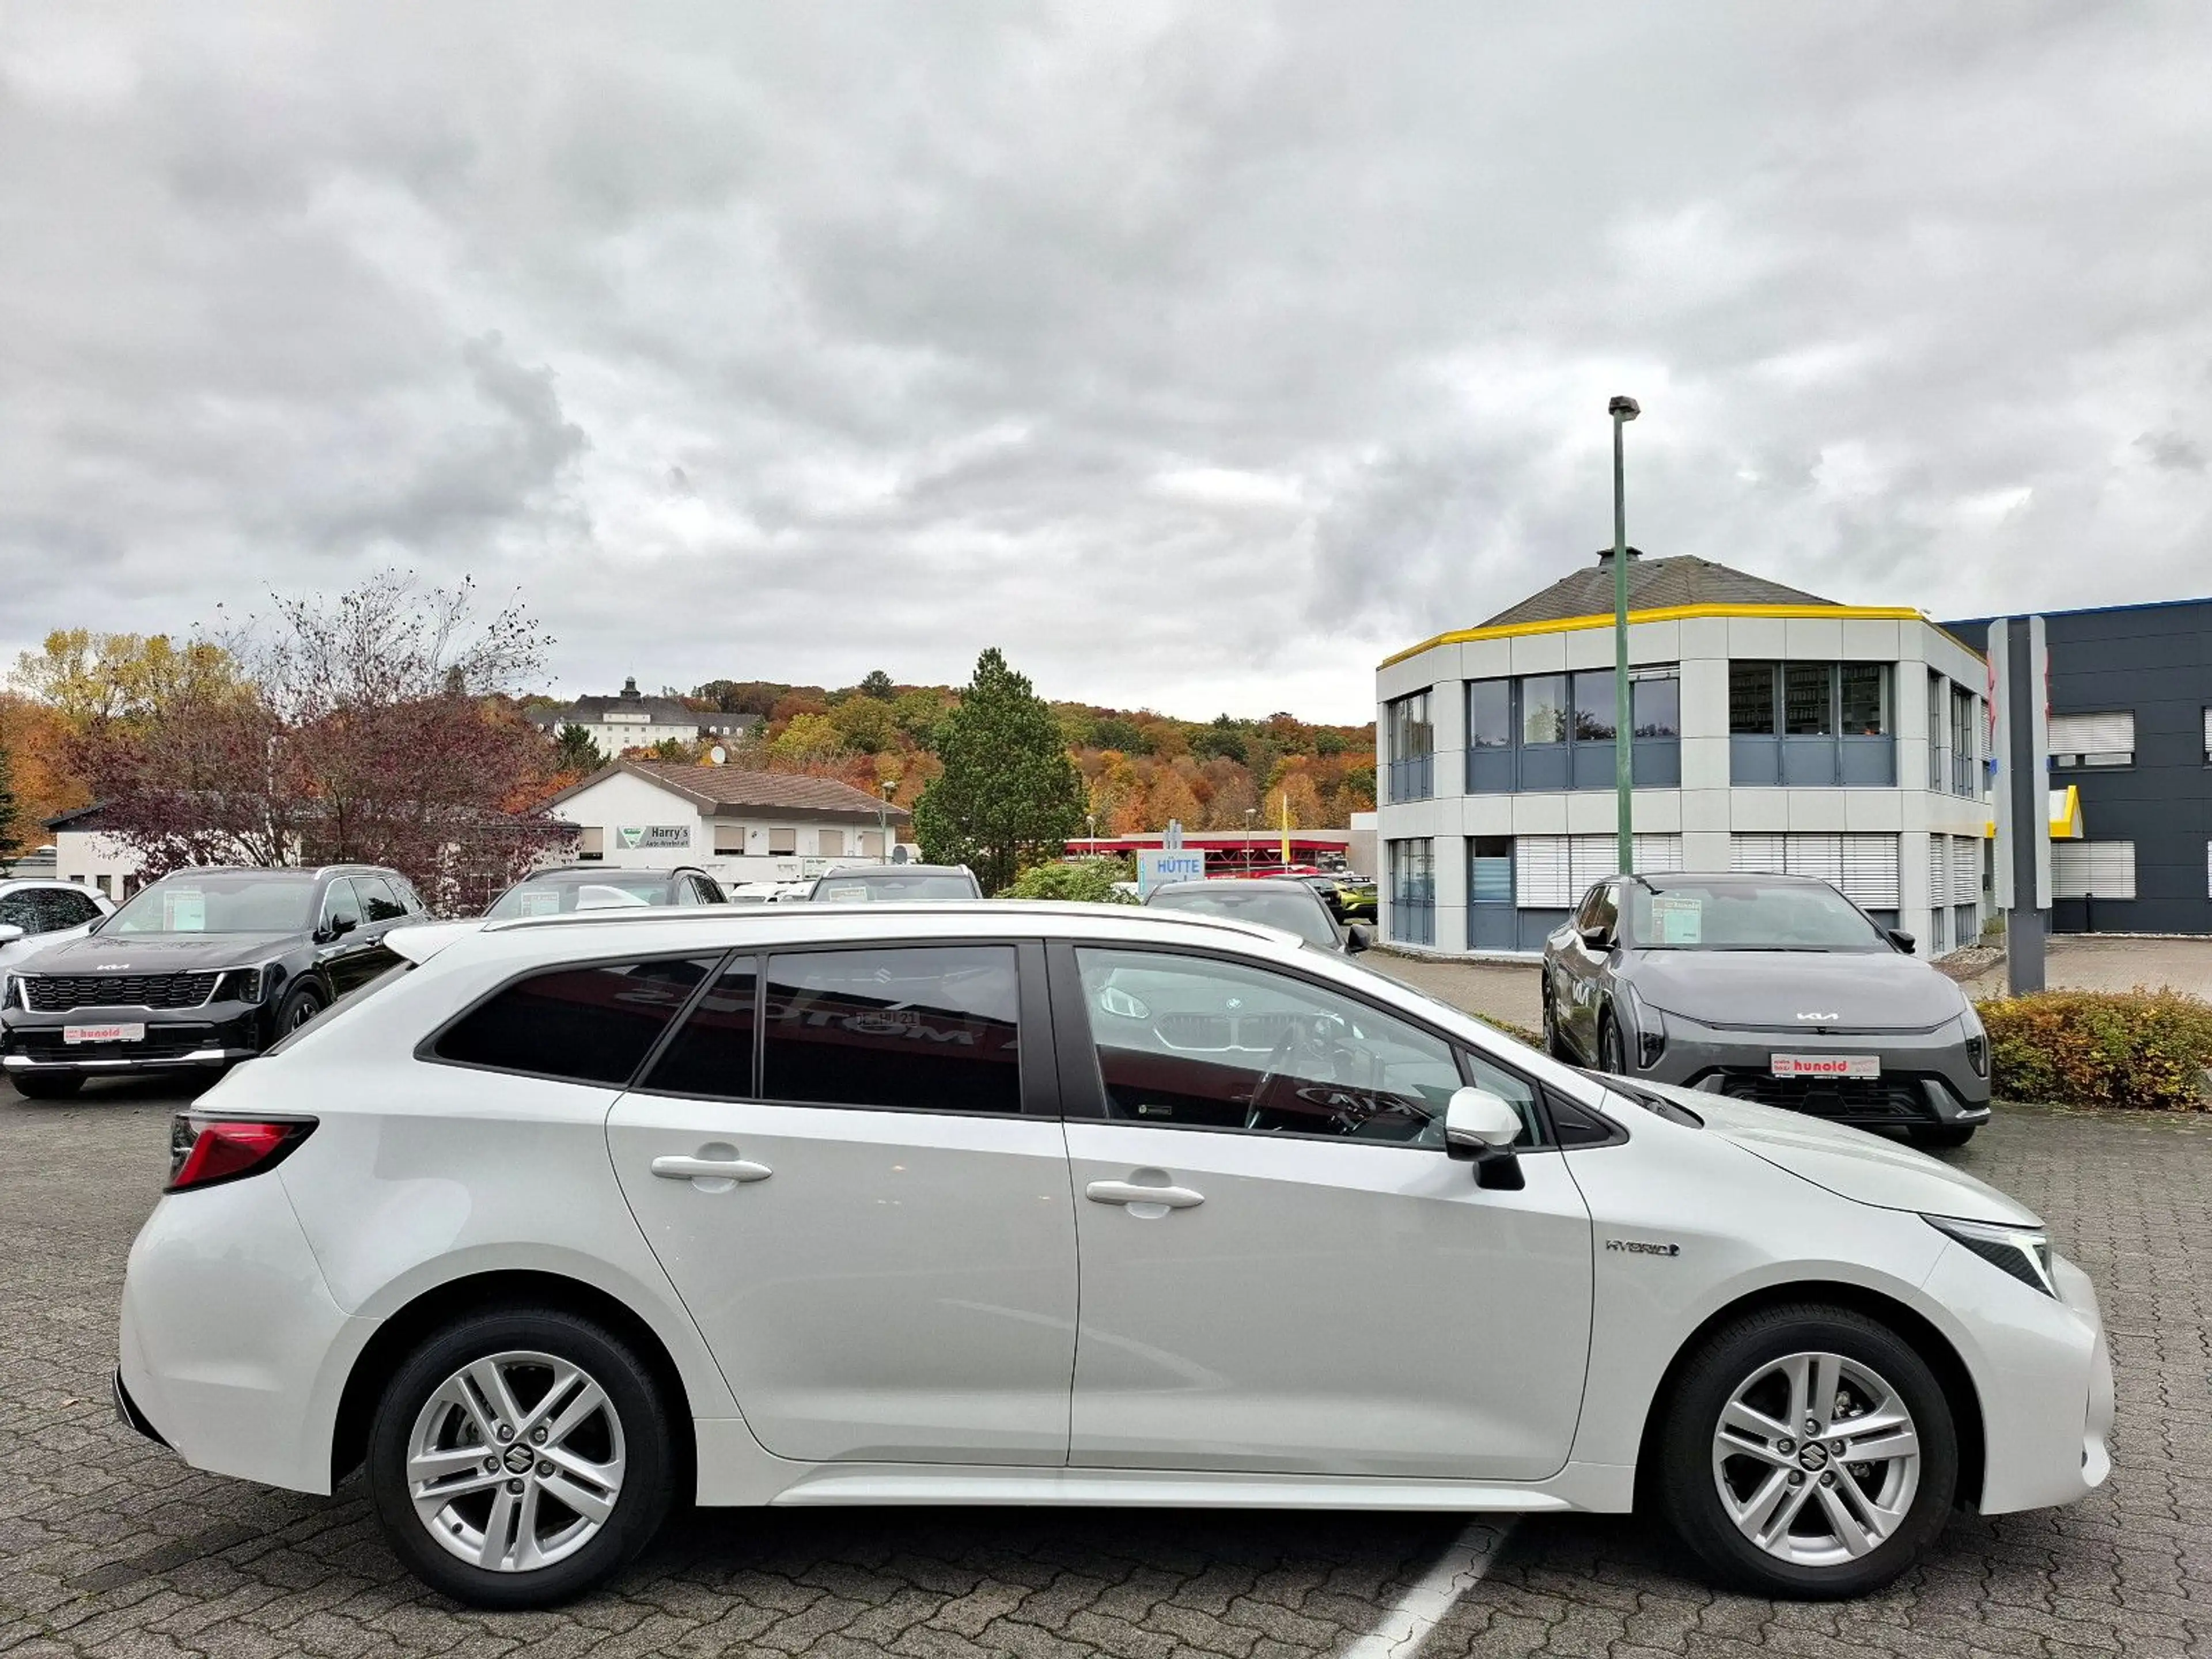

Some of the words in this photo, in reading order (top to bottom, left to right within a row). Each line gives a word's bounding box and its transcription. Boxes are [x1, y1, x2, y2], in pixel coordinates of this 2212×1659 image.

[652, 827, 688, 839] Harry's
[1157, 855, 1200, 873] HÜTTE
[1794, 1059, 1848, 1072] hunold
